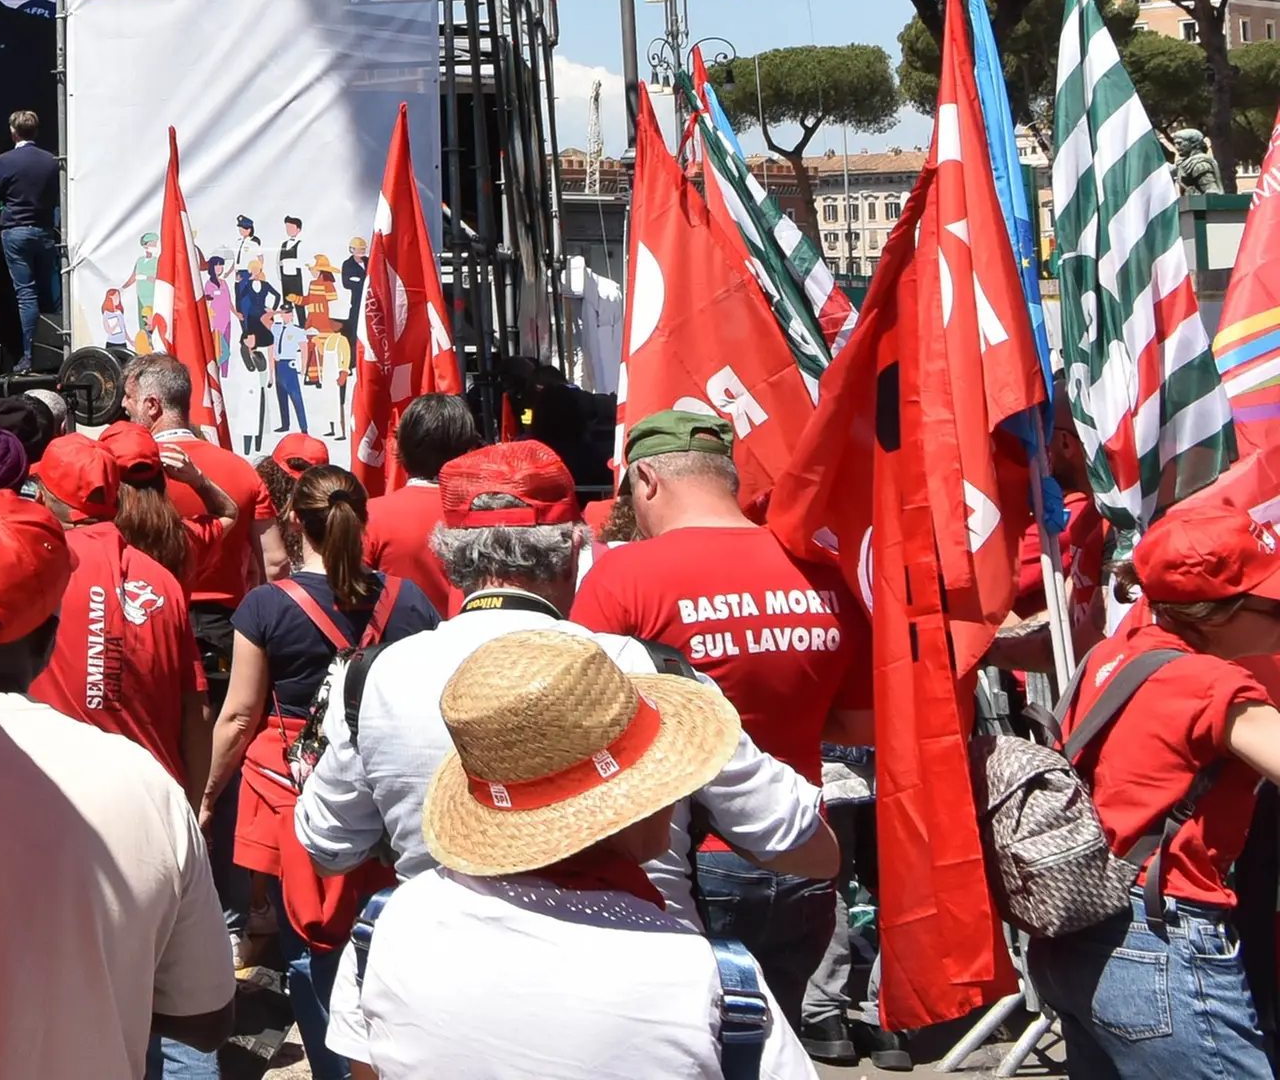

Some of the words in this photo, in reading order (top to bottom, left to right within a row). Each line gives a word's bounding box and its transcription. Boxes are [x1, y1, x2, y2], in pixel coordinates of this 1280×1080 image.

[466, 596, 505, 610] Nikon
[678, 592, 760, 624] BASTA
[765, 589, 840, 615] MORTI
[86, 585, 106, 710] SEMINIAMO
[690, 631, 740, 659] SUL
[745, 626, 840, 654] LAVORO
[600, 761, 618, 775] SPI
